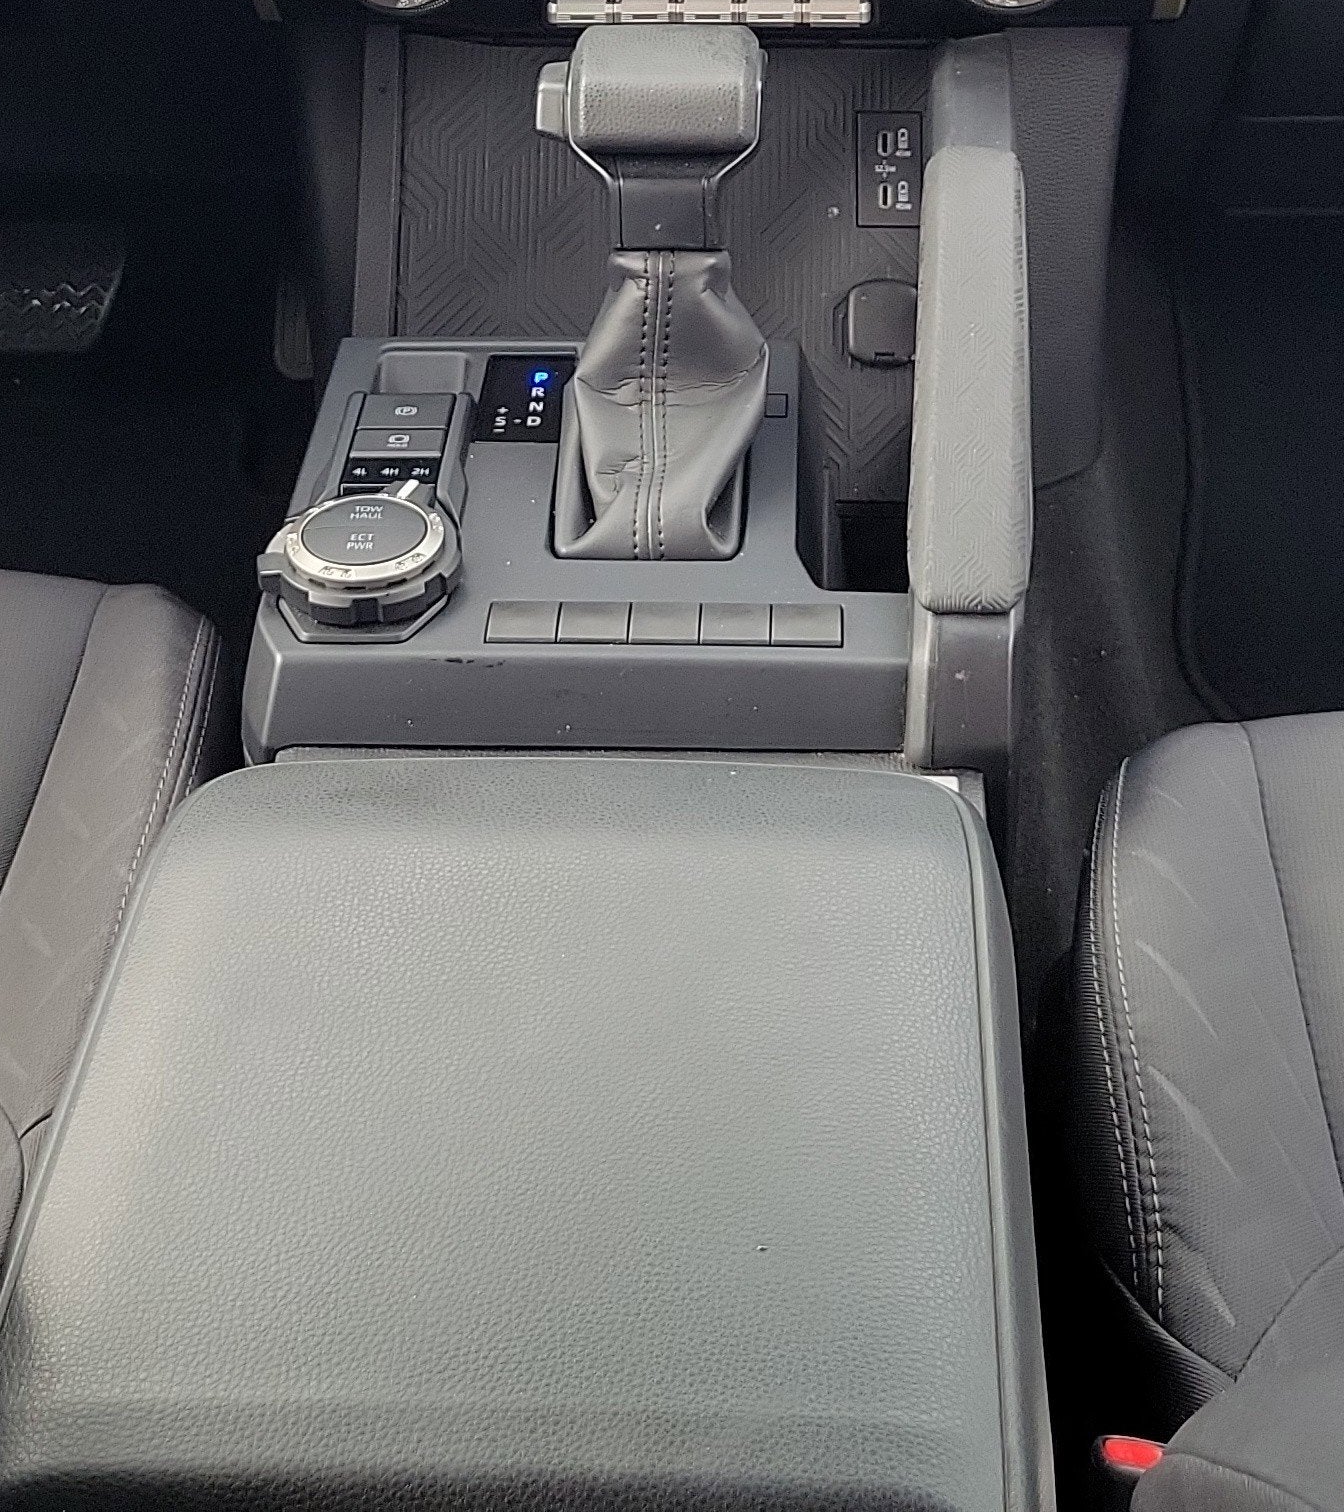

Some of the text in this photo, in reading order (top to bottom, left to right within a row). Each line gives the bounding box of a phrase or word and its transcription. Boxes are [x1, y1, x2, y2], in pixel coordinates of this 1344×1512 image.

[534, 371, 549, 385] P
[531, 386, 545, 399] R
[528, 400, 544, 413] N
[494, 416, 507, 428] S
[526, 416, 542, 427] D
[380, 467, 400, 477] 4H
[411, 467, 430, 477] 2H
[355, 505, 384, 513] TOW
[350, 512, 384, 520] HAUL
[350, 533, 375, 541] ECT
[346, 541, 374, 550] PWR
